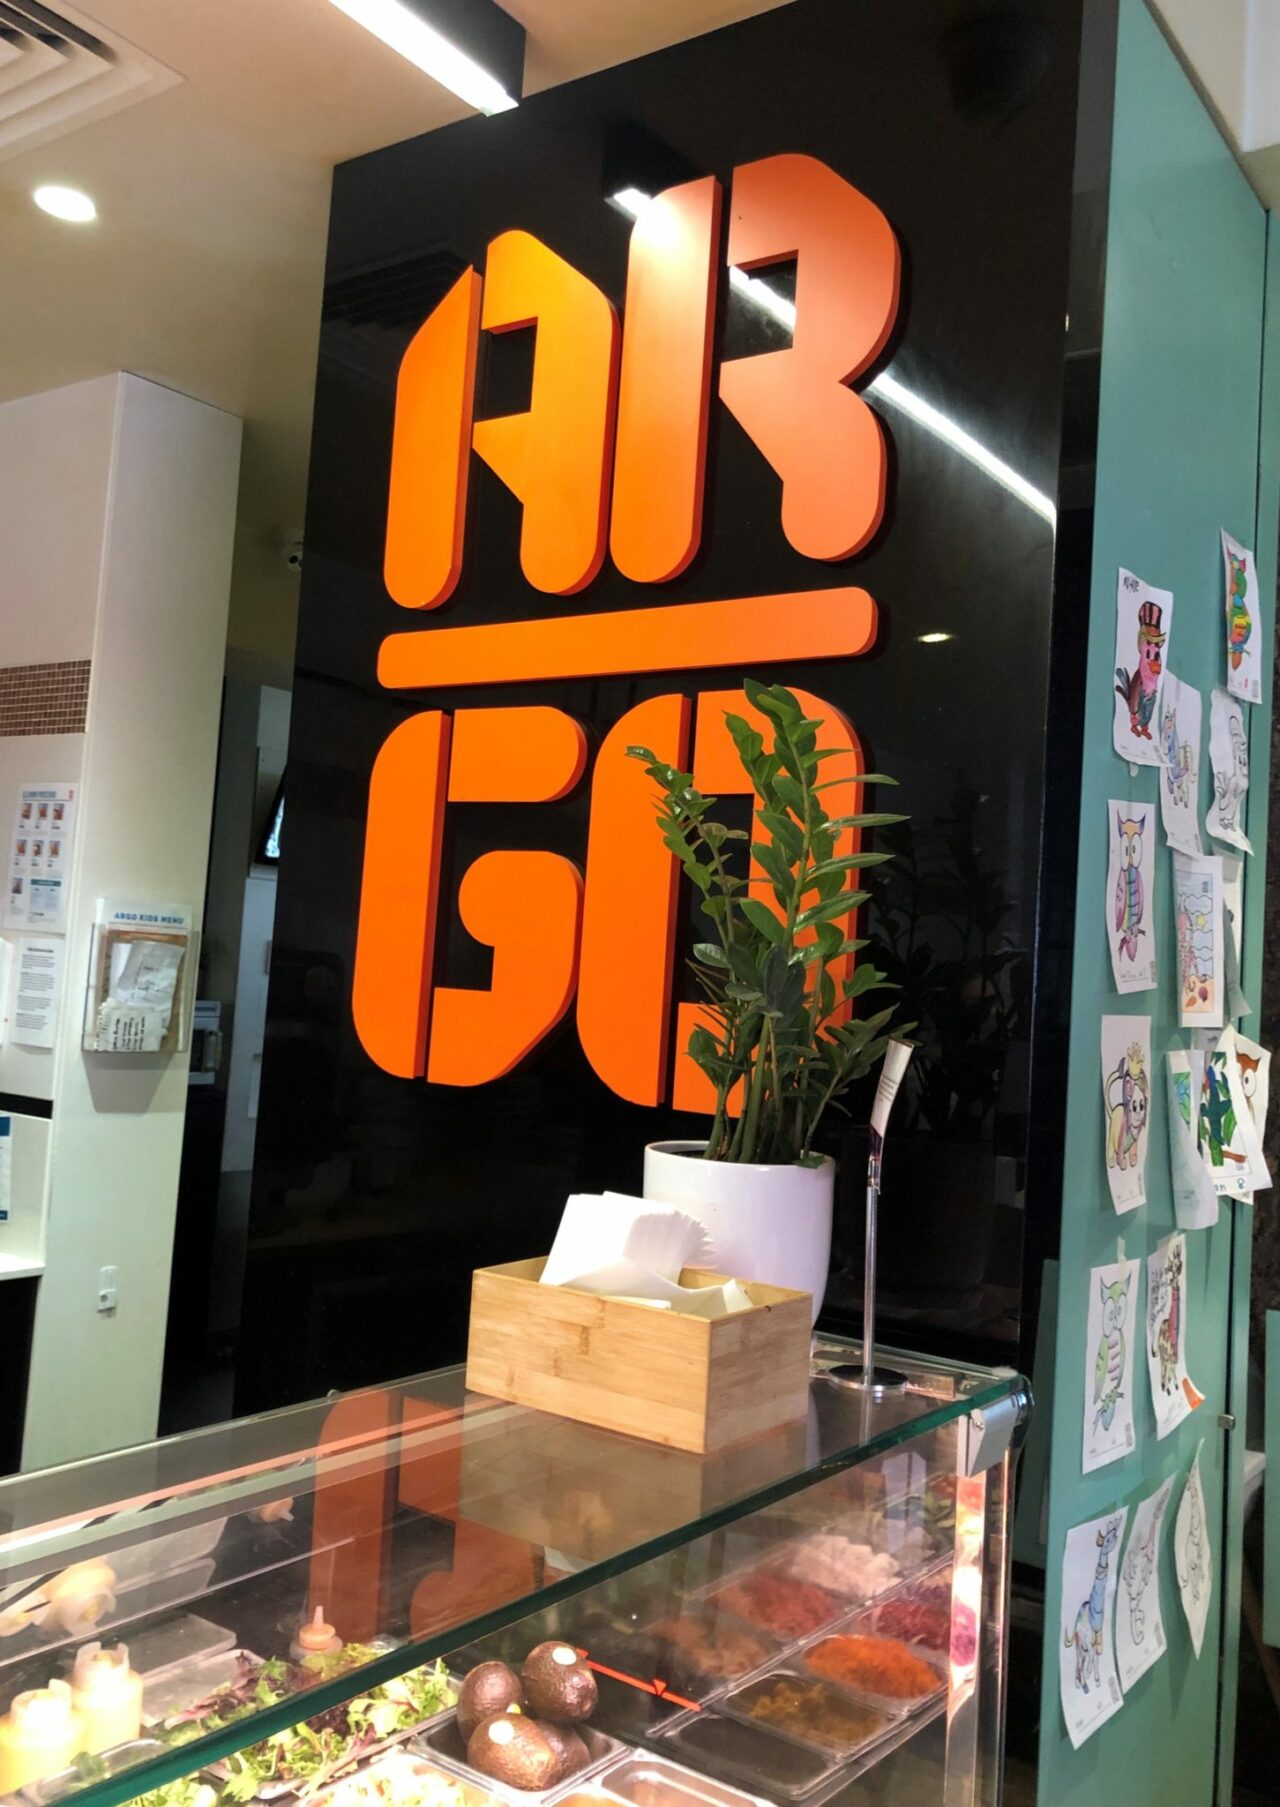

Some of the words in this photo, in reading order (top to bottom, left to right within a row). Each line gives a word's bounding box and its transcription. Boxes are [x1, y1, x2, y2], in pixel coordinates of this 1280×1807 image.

[383, 152, 901, 610] AR
[115, 911, 138, 921] ARGO
[139, 914, 159, 923] KIDS
[161, 916, 185, 925] MENU
[351, 686, 865, 1118] GO
